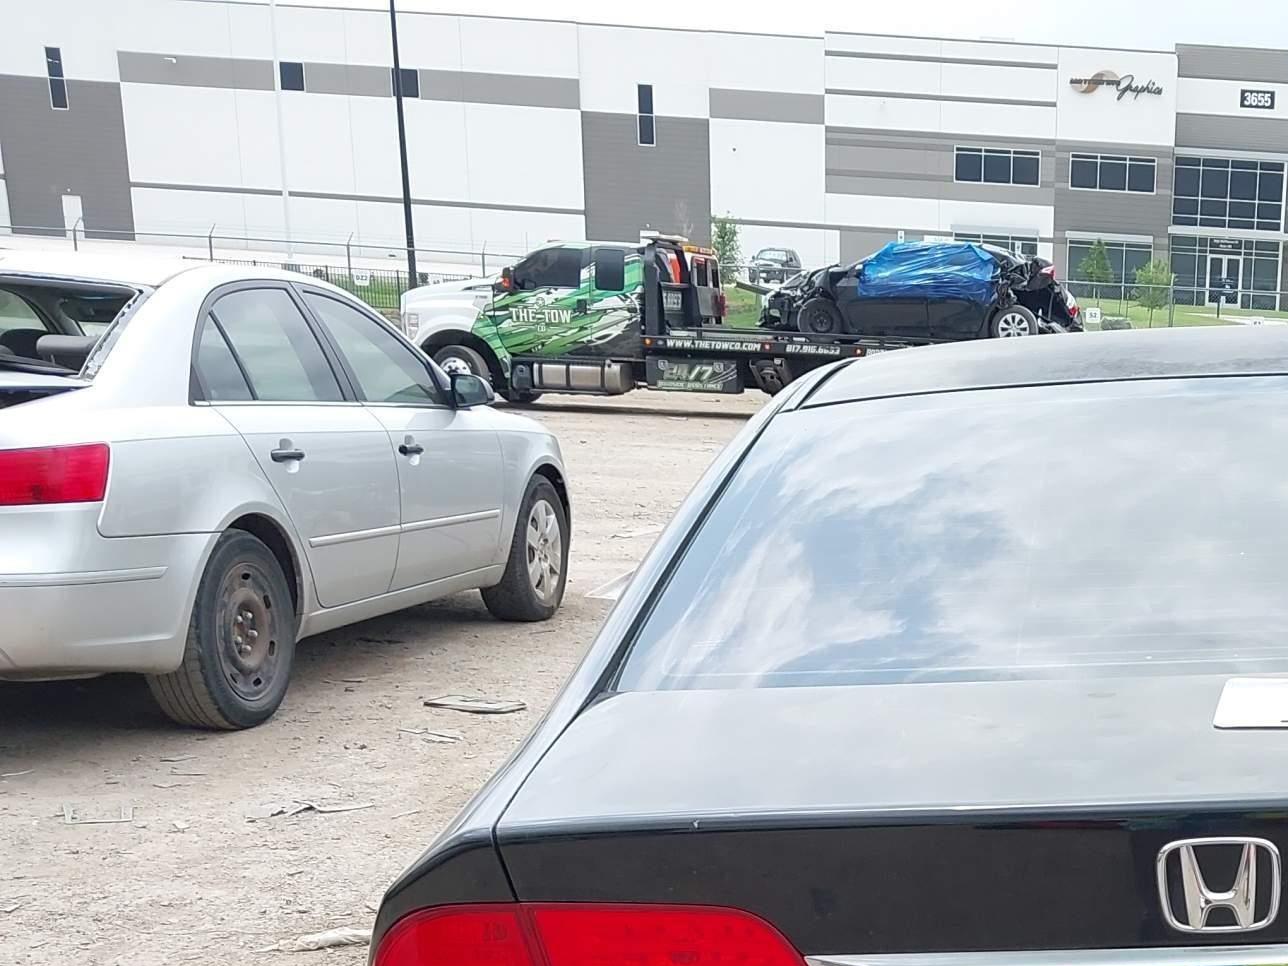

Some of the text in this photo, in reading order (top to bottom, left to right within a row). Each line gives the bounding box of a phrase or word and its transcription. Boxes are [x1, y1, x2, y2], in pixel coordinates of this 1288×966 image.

[1116, 75, 1163, 101] Graphics
[1243, 92, 1272, 107] 3655
[509, 308, 572, 324] THE TOW
[666, 338, 761, 352] WWW.THETOWCO.COM
[663, 363, 713, 381] 24/7
